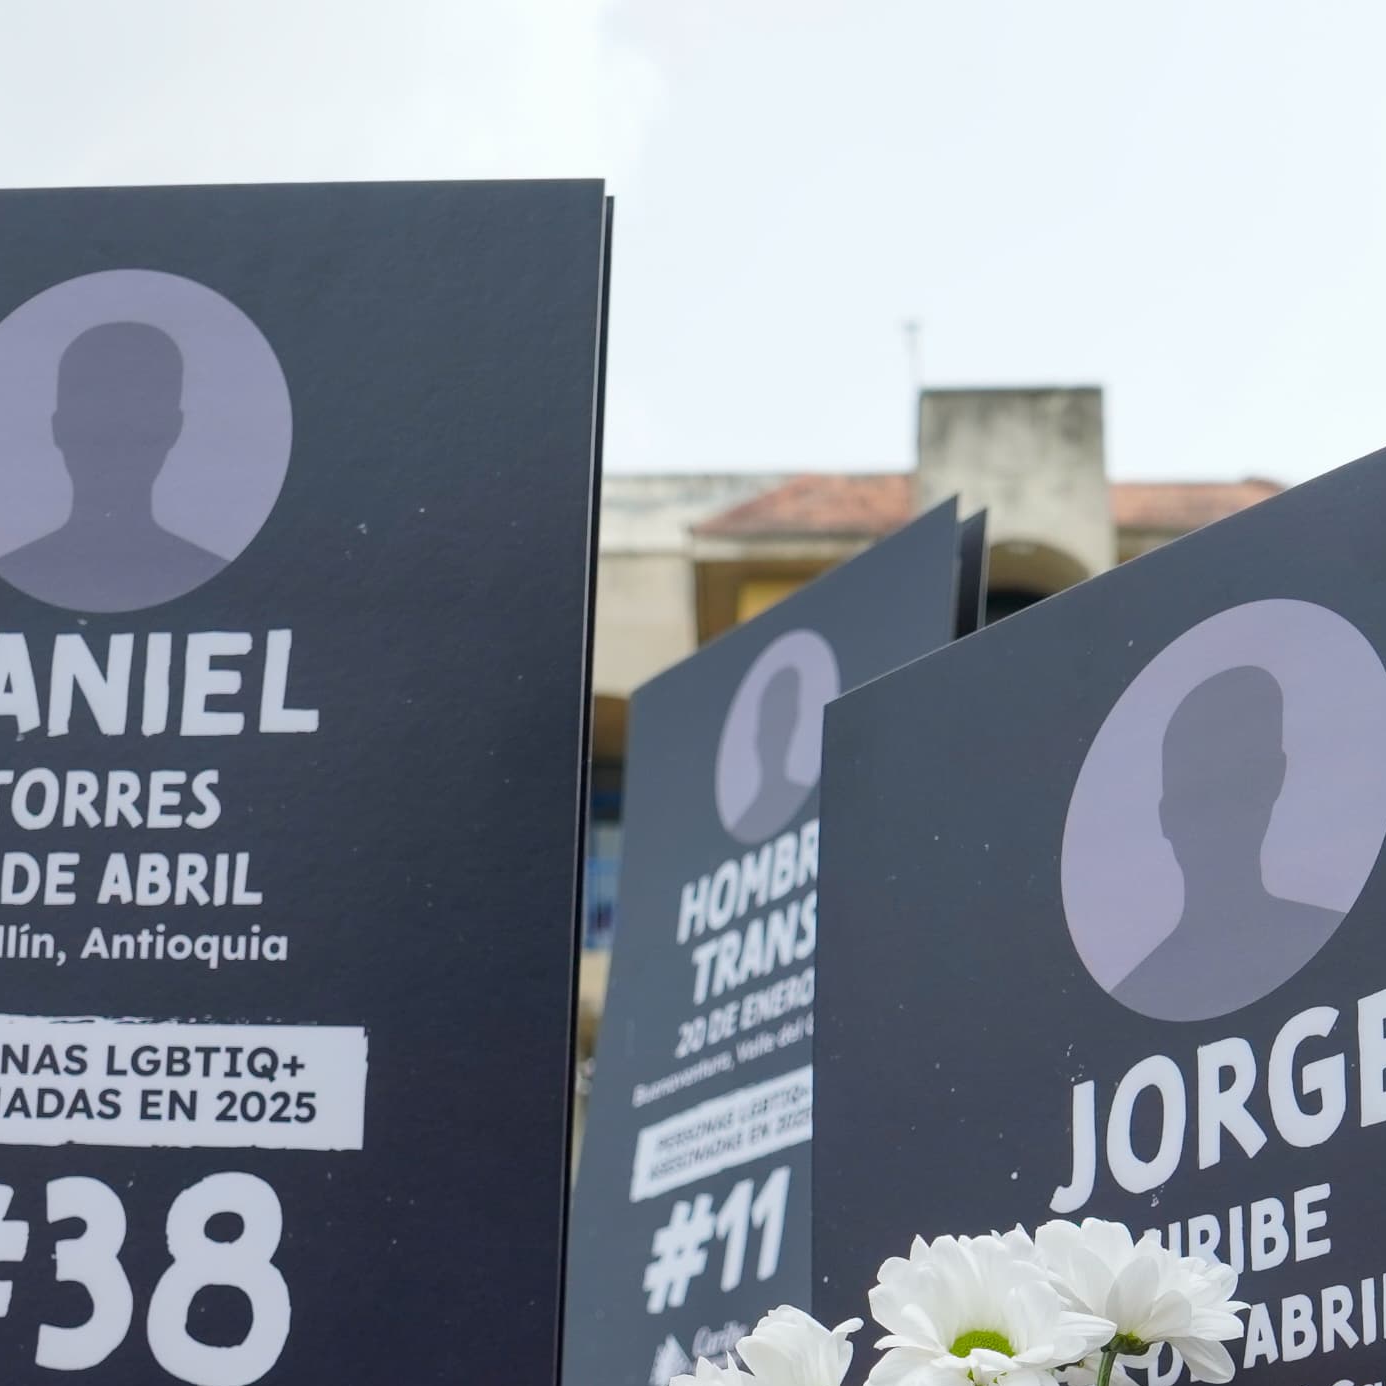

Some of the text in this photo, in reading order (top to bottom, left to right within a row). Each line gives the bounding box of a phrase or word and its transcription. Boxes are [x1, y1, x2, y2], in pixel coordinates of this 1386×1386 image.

[0, 852, 80, 906] DE
[97, 852, 263, 907] ABRIL
[80, 924, 288, 970] Antioquia
[693, 890, 817, 1006] TRANS
[674, 1015, 707, 1060] 20
[707, 1001, 740, 1046] DE
[739, 967, 814, 1031] ENERO
[106, 1044, 305, 1083] LGBTIQ+
[139, 1089, 198, 1121] EN
[215, 1090, 317, 1124] 2025
[642, 1165, 792, 1314] #11
